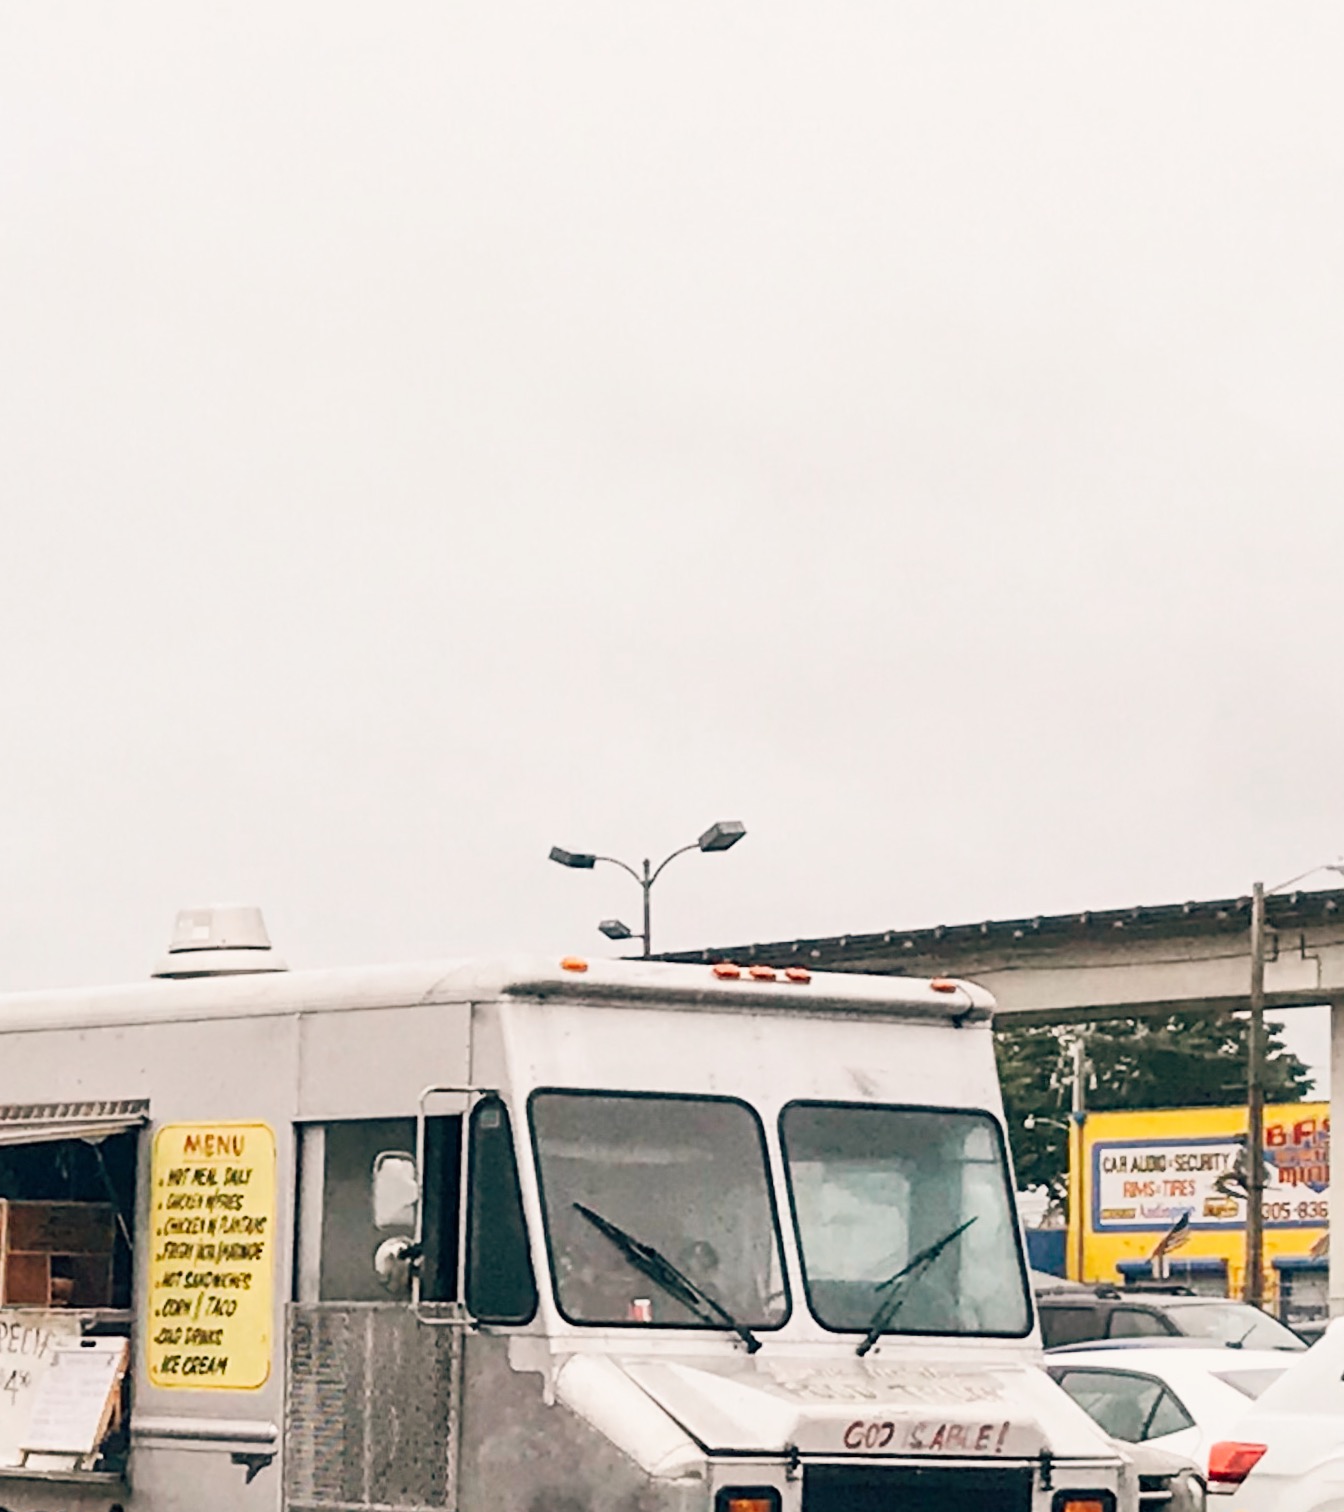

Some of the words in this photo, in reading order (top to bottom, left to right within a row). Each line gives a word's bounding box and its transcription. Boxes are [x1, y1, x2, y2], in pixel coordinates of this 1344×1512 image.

[183, 1133, 245, 1157] MENU
[1103, 1156, 1127, 1173] CAR
[1130, 1154, 1166, 1173] AUDIO
[1173, 1152, 1231, 1172] SECURITY
[1123, 1181, 1155, 1198] RIMS
[1162, 1180, 1196, 1198] TIRES
[205, 1296, 237, 1318] TACO
[161, 1355, 181, 1374] ICE
[182, 1355, 229, 1376] CREAM
[843, 1420, 896, 1450] GOD
